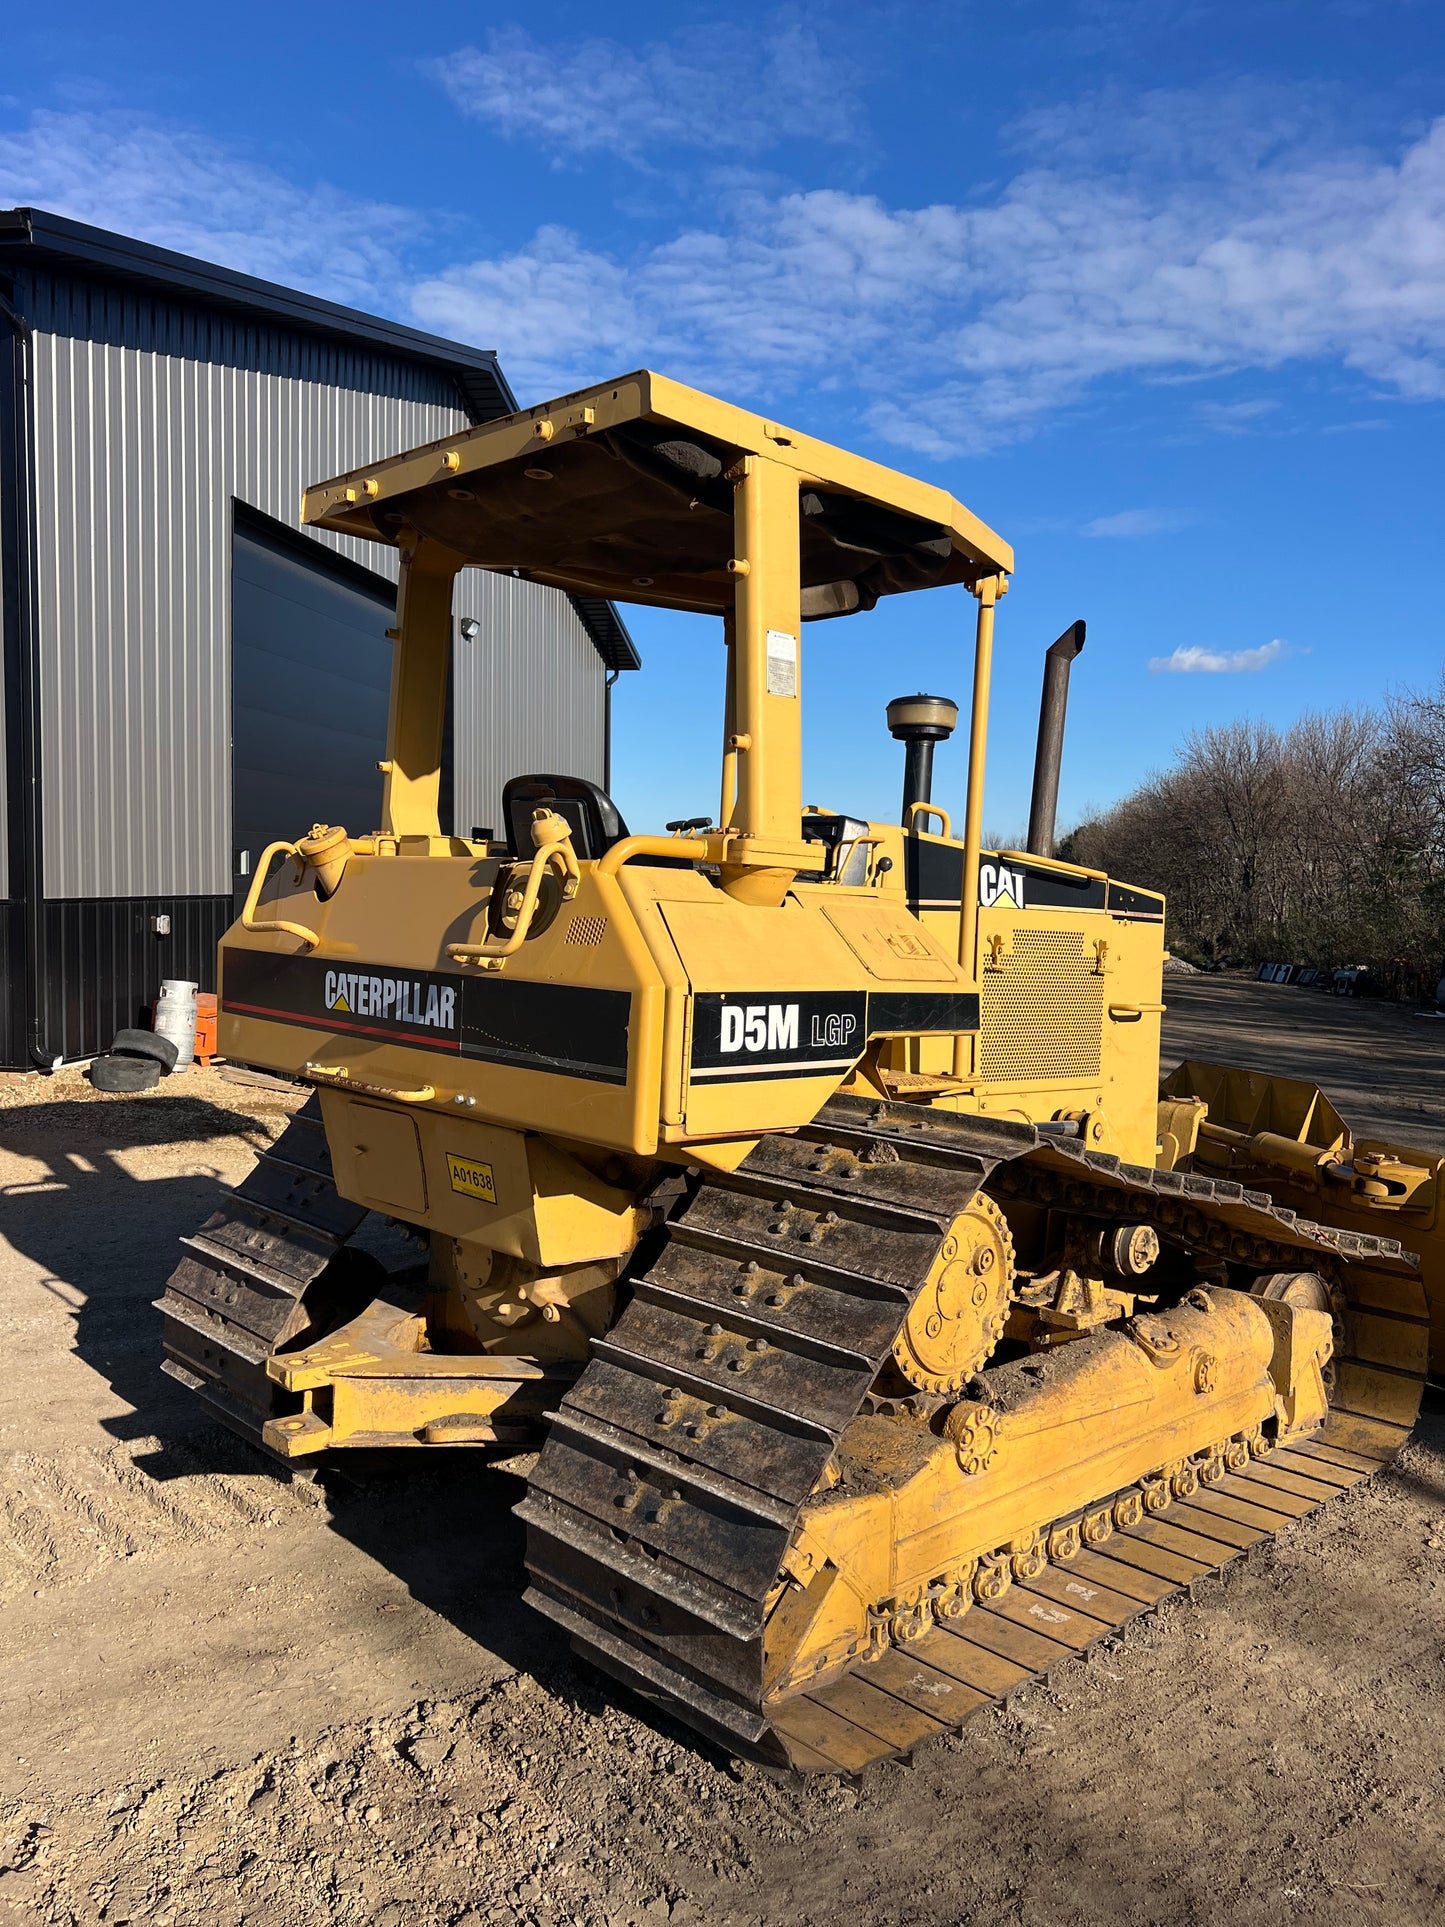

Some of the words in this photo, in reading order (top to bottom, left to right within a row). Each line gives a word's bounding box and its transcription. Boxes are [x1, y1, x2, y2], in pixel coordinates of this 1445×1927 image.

[980, 864, 1026, 909] CAT
[324, 970, 455, 1030] CATERPILLAR
[720, 1004, 800, 1053] D5M
[811, 1014, 857, 1047] LGP
[453, 1165, 493, 1191] A01638
